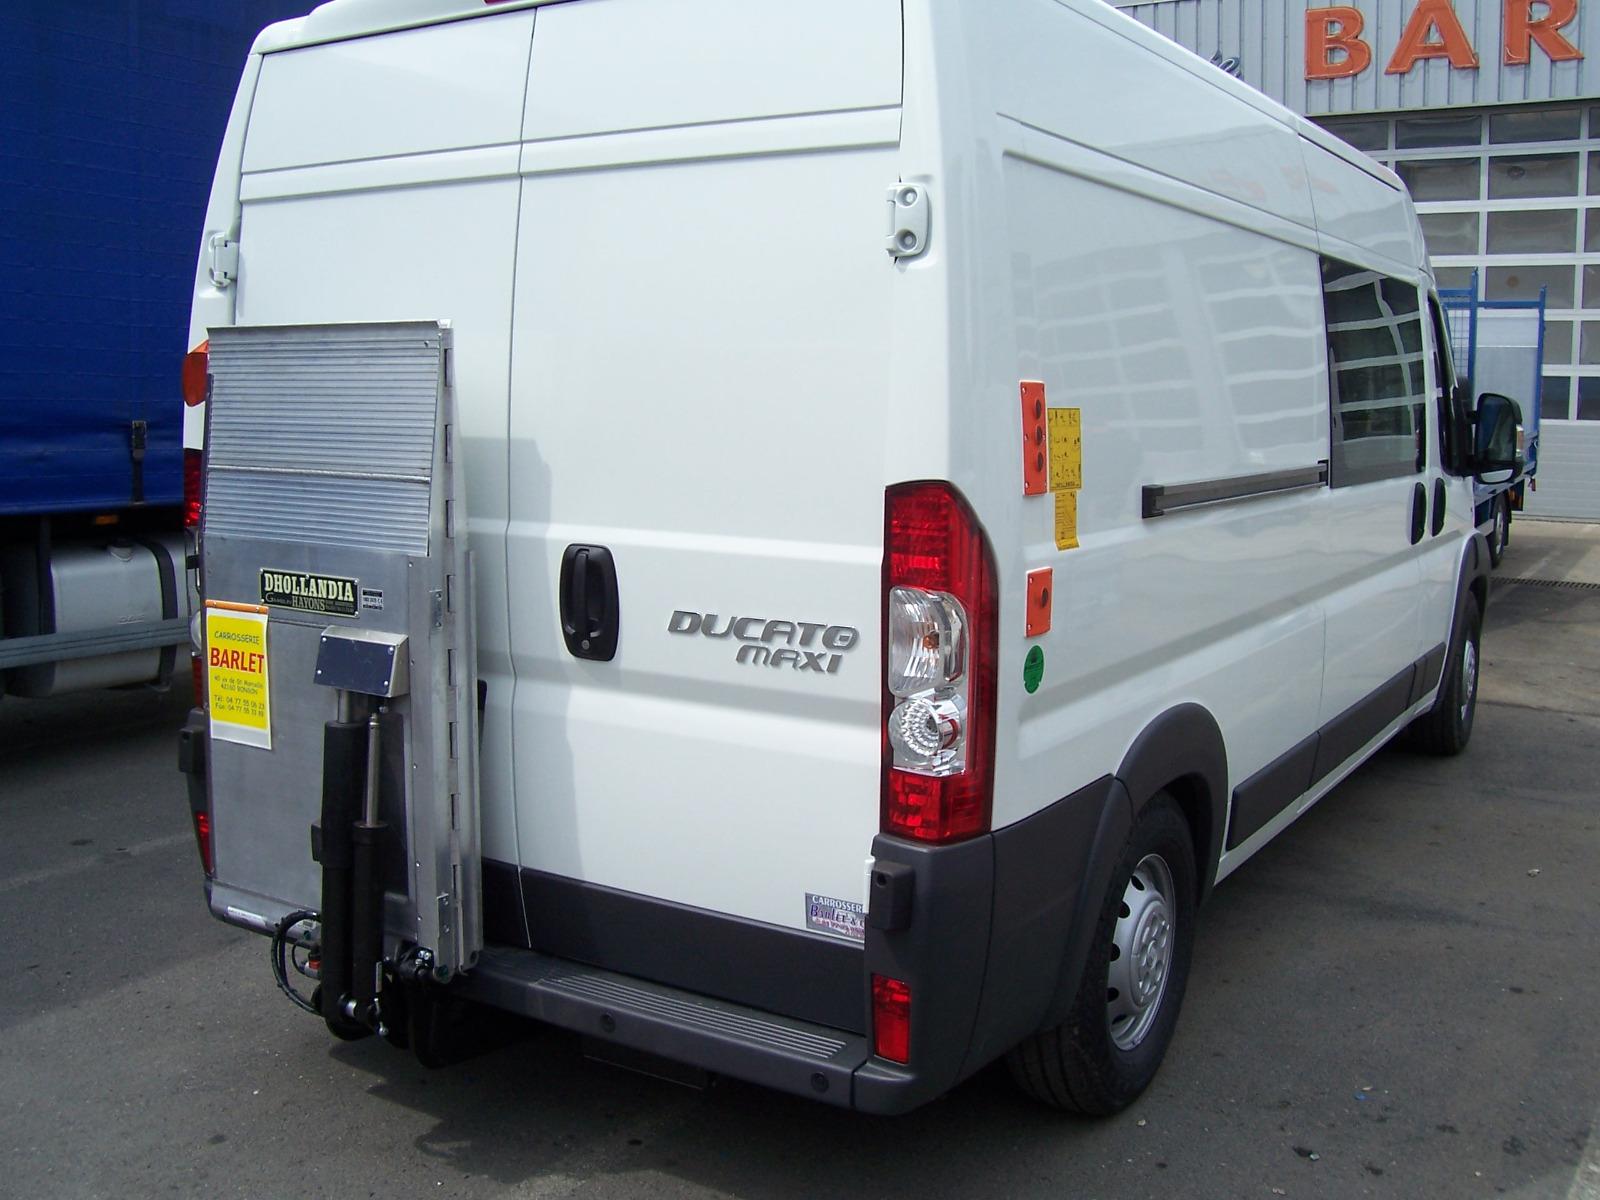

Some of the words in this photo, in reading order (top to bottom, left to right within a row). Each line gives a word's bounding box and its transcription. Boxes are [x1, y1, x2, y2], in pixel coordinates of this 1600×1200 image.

[1304, 0, 1585, 80] BAR
[264, 572, 354, 602] DHOLLANDIA
[292, 595, 326, 611] HAYONS
[214, 631, 260, 645] CARROSSERIE
[667, 610, 861, 652] DUCATO
[210, 647, 265, 674] BARLET
[735, 644, 844, 675] MAXI
